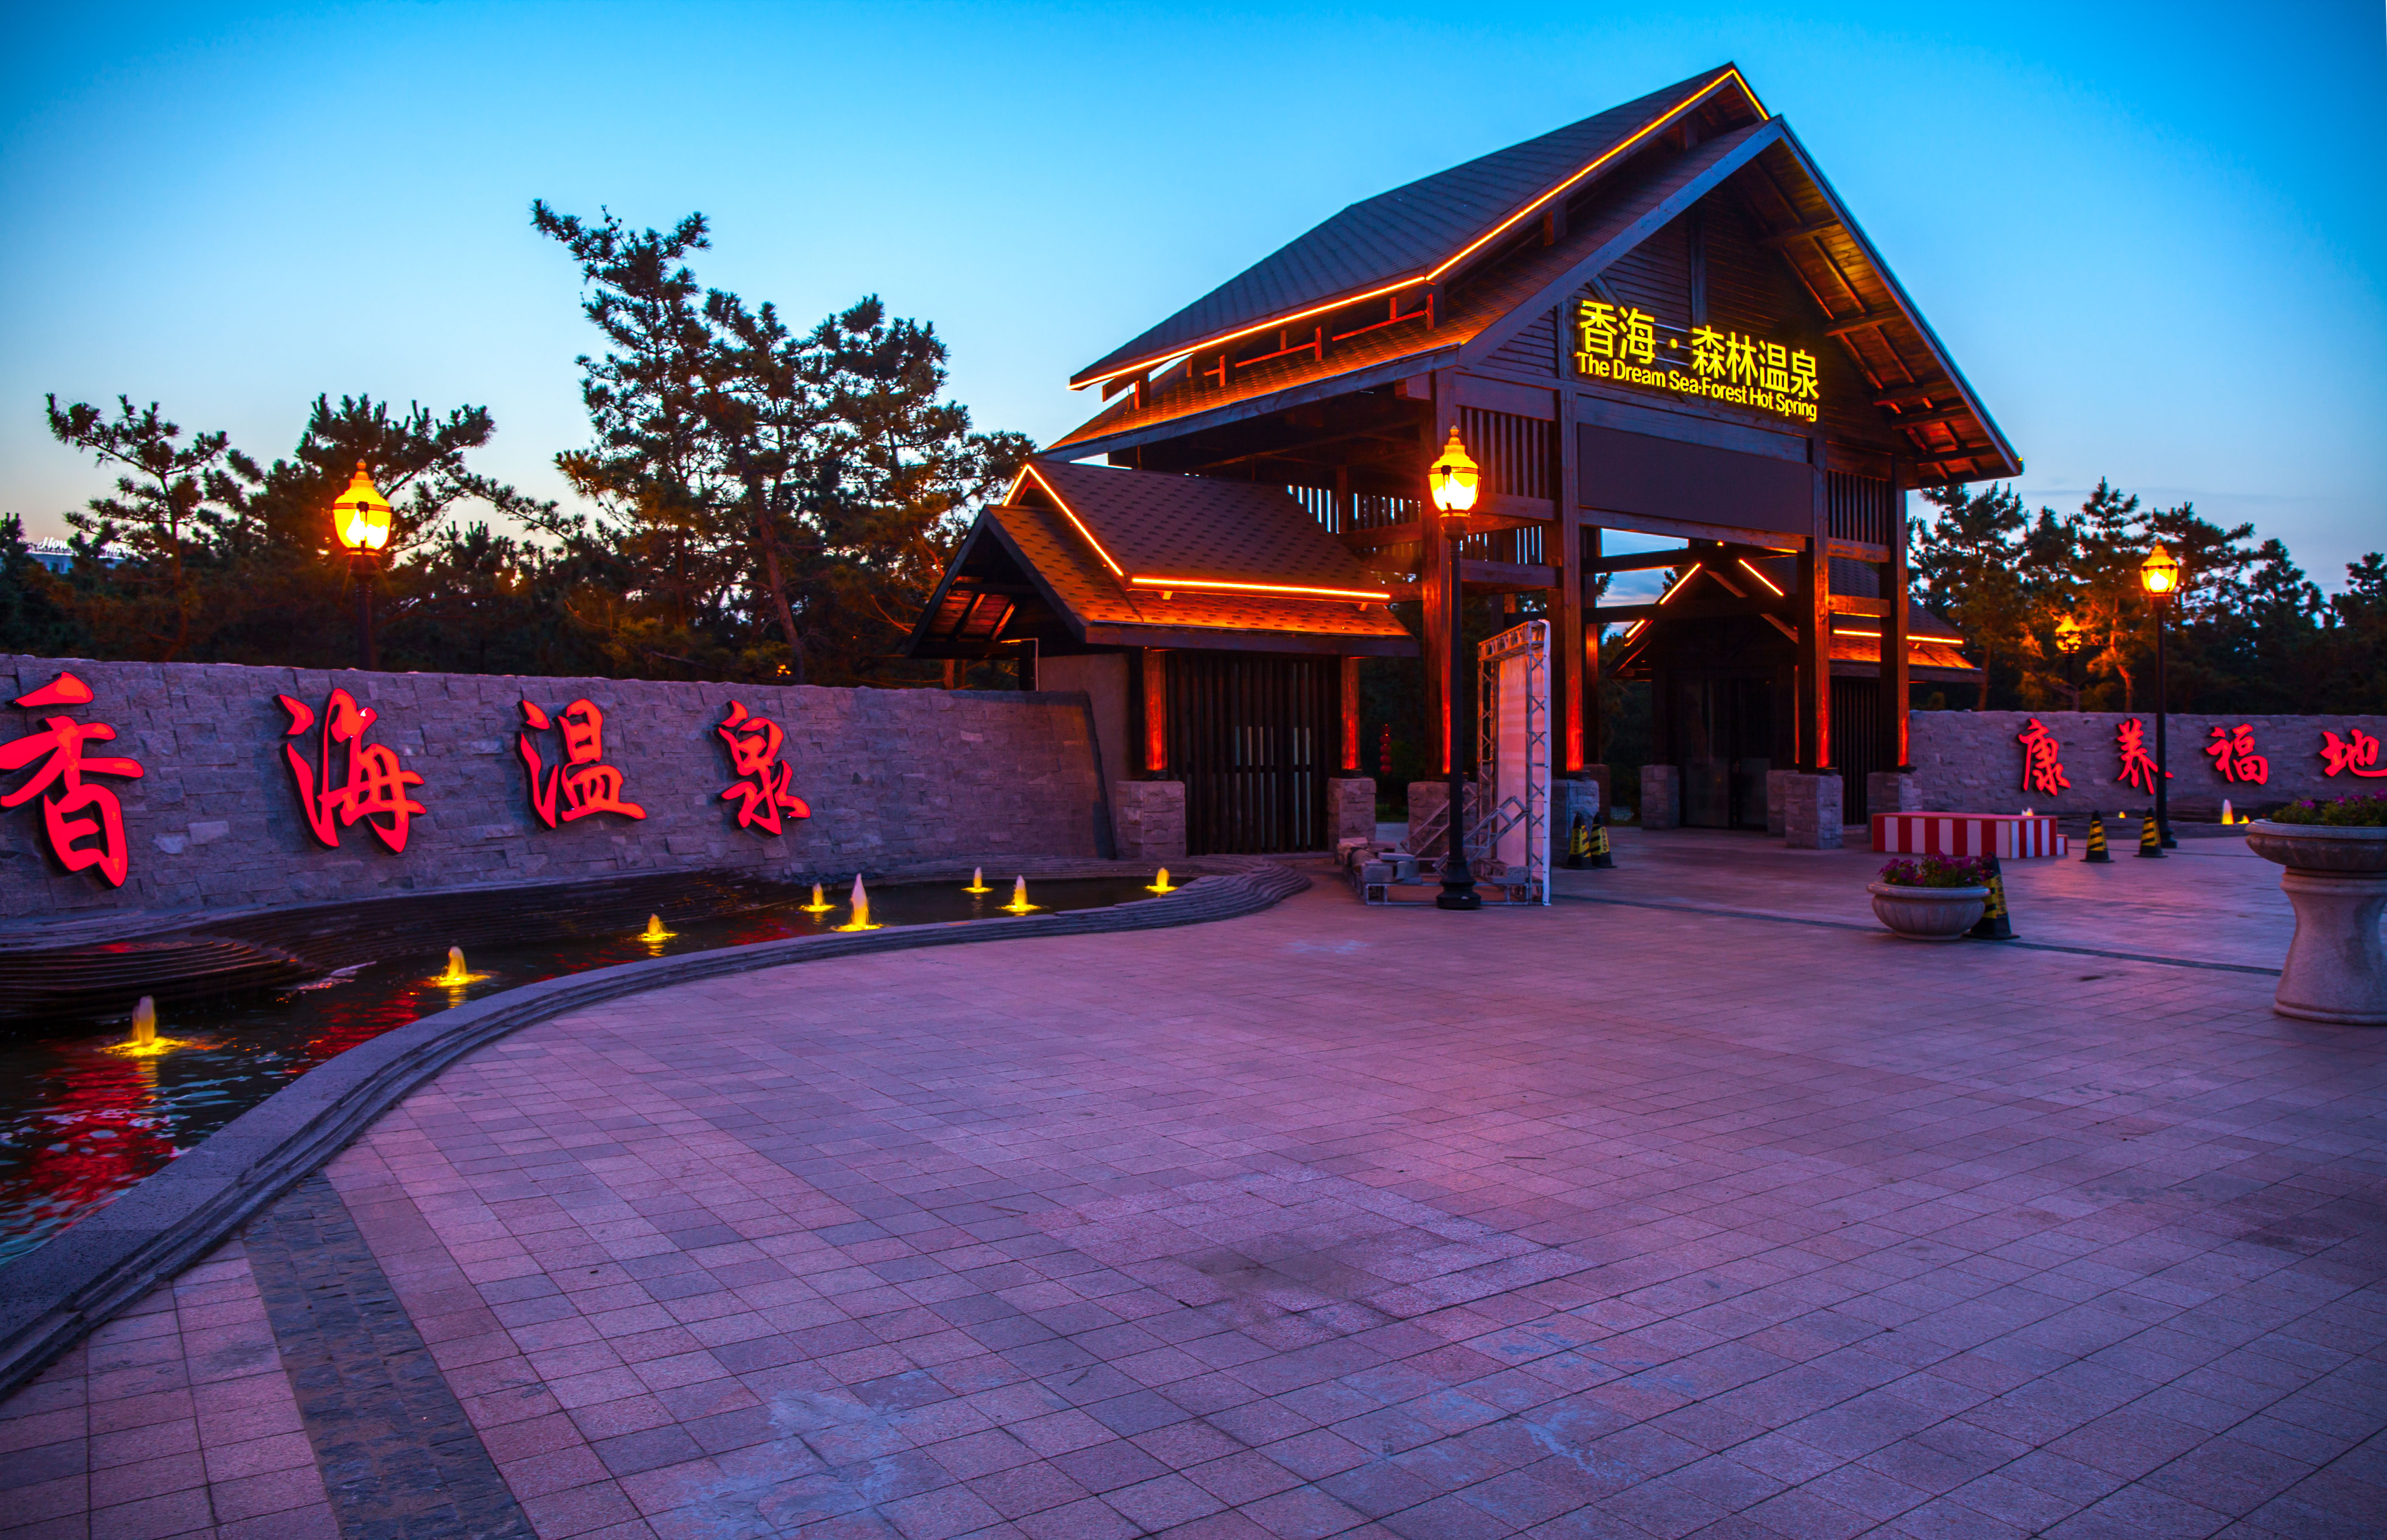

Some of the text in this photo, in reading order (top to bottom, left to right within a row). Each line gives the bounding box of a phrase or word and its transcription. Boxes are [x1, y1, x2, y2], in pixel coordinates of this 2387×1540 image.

[1574, 351, 1610, 377] The
[1612, 359, 1666, 388] Dream
[1749, 386, 1774, 410] Hot
[1776, 392, 1817, 422] Spring
